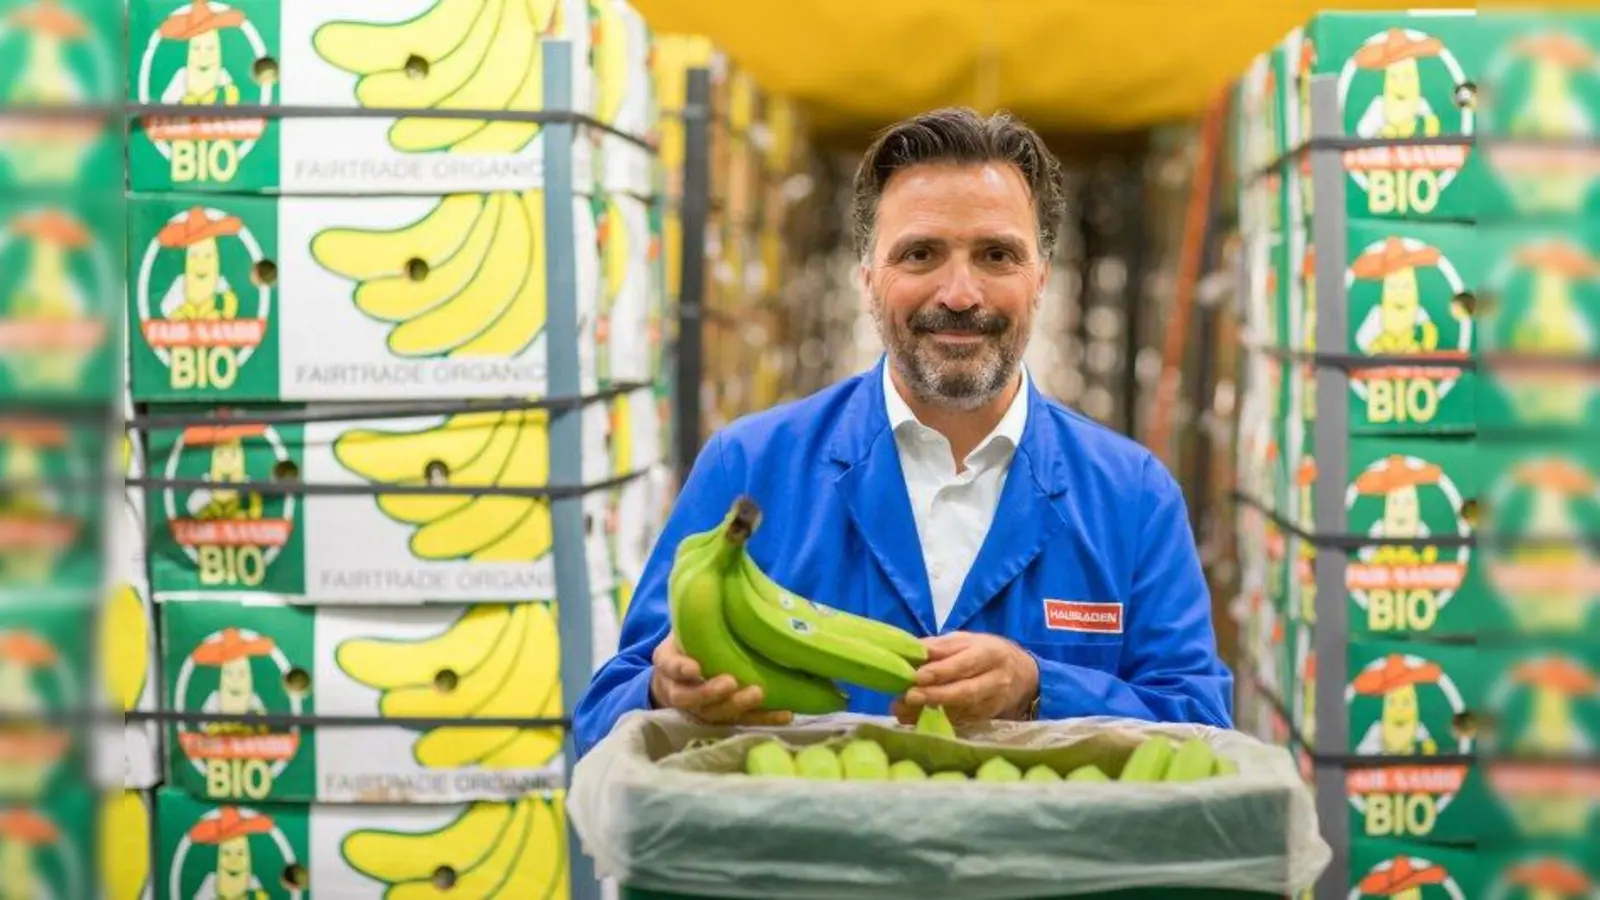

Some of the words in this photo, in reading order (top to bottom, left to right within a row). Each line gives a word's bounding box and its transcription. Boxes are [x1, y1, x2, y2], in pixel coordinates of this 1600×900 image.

[171, 139, 238, 182] BIO
[295, 158, 422, 180] FAIRTRADE
[432, 158, 543, 180] ORGANIC
[1368, 168, 1440, 214] BIO
[171, 346, 238, 389] BIO
[295, 361, 421, 384] FAIRTRADE
[432, 361, 545, 384] ORGANIC
[1367, 377, 1438, 423] BIO
[199, 545, 264, 585] BIO
[320, 568, 443, 590] FAIRTRADE
[456, 568, 554, 590] ORGANI
[1368, 588, 1438, 631] BIO
[207, 758, 272, 799] BIO
[325, 773, 447, 793] FAIRTRADE
[1365, 792, 1437, 836] BIO
